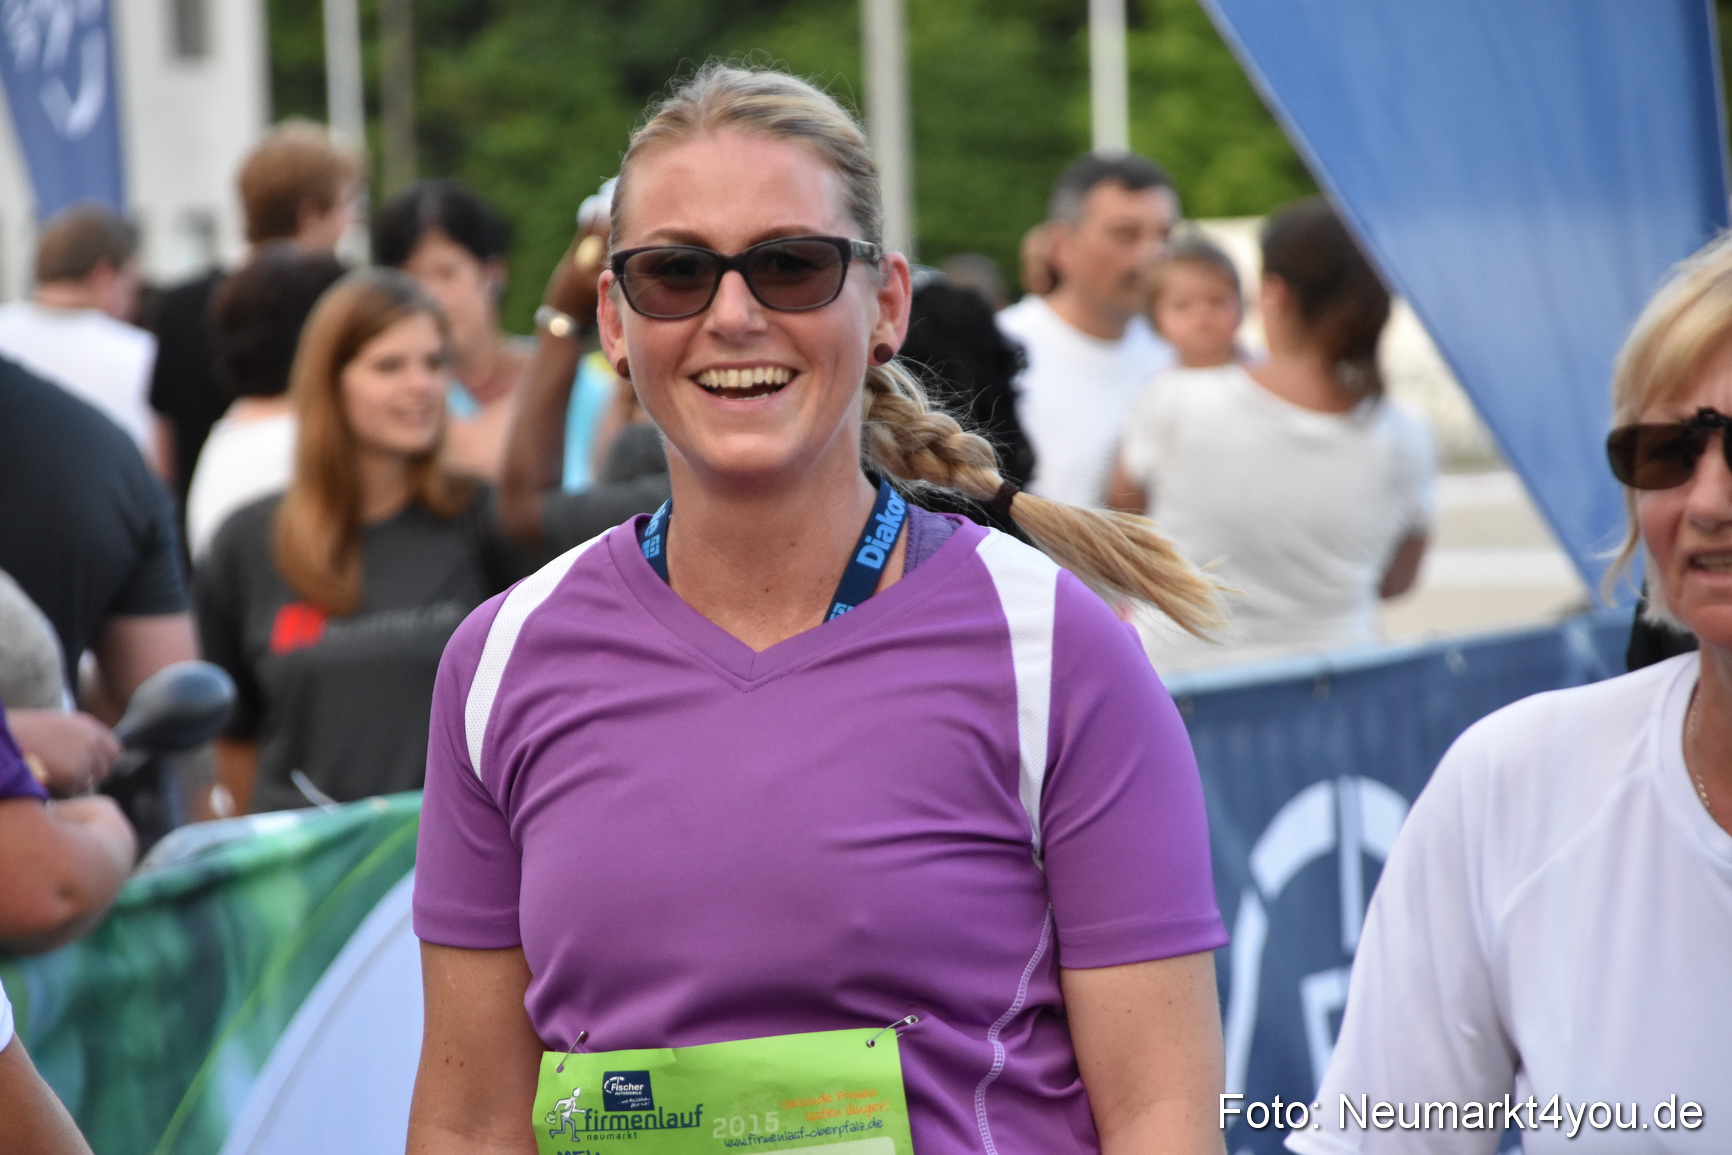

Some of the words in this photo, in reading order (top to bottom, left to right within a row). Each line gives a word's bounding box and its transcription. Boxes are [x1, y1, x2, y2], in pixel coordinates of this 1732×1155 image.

[610, 1082, 644, 1092] Fischer
[583, 1103, 703, 1131] firmenlauf
[712, 1111, 780, 1139] 2015
[805, 1106, 842, 1122] laufen
[586, 1131, 638, 1141] neumarkt
[724, 1117, 883, 1148] www.firmenlauf-oberpfalz.de
